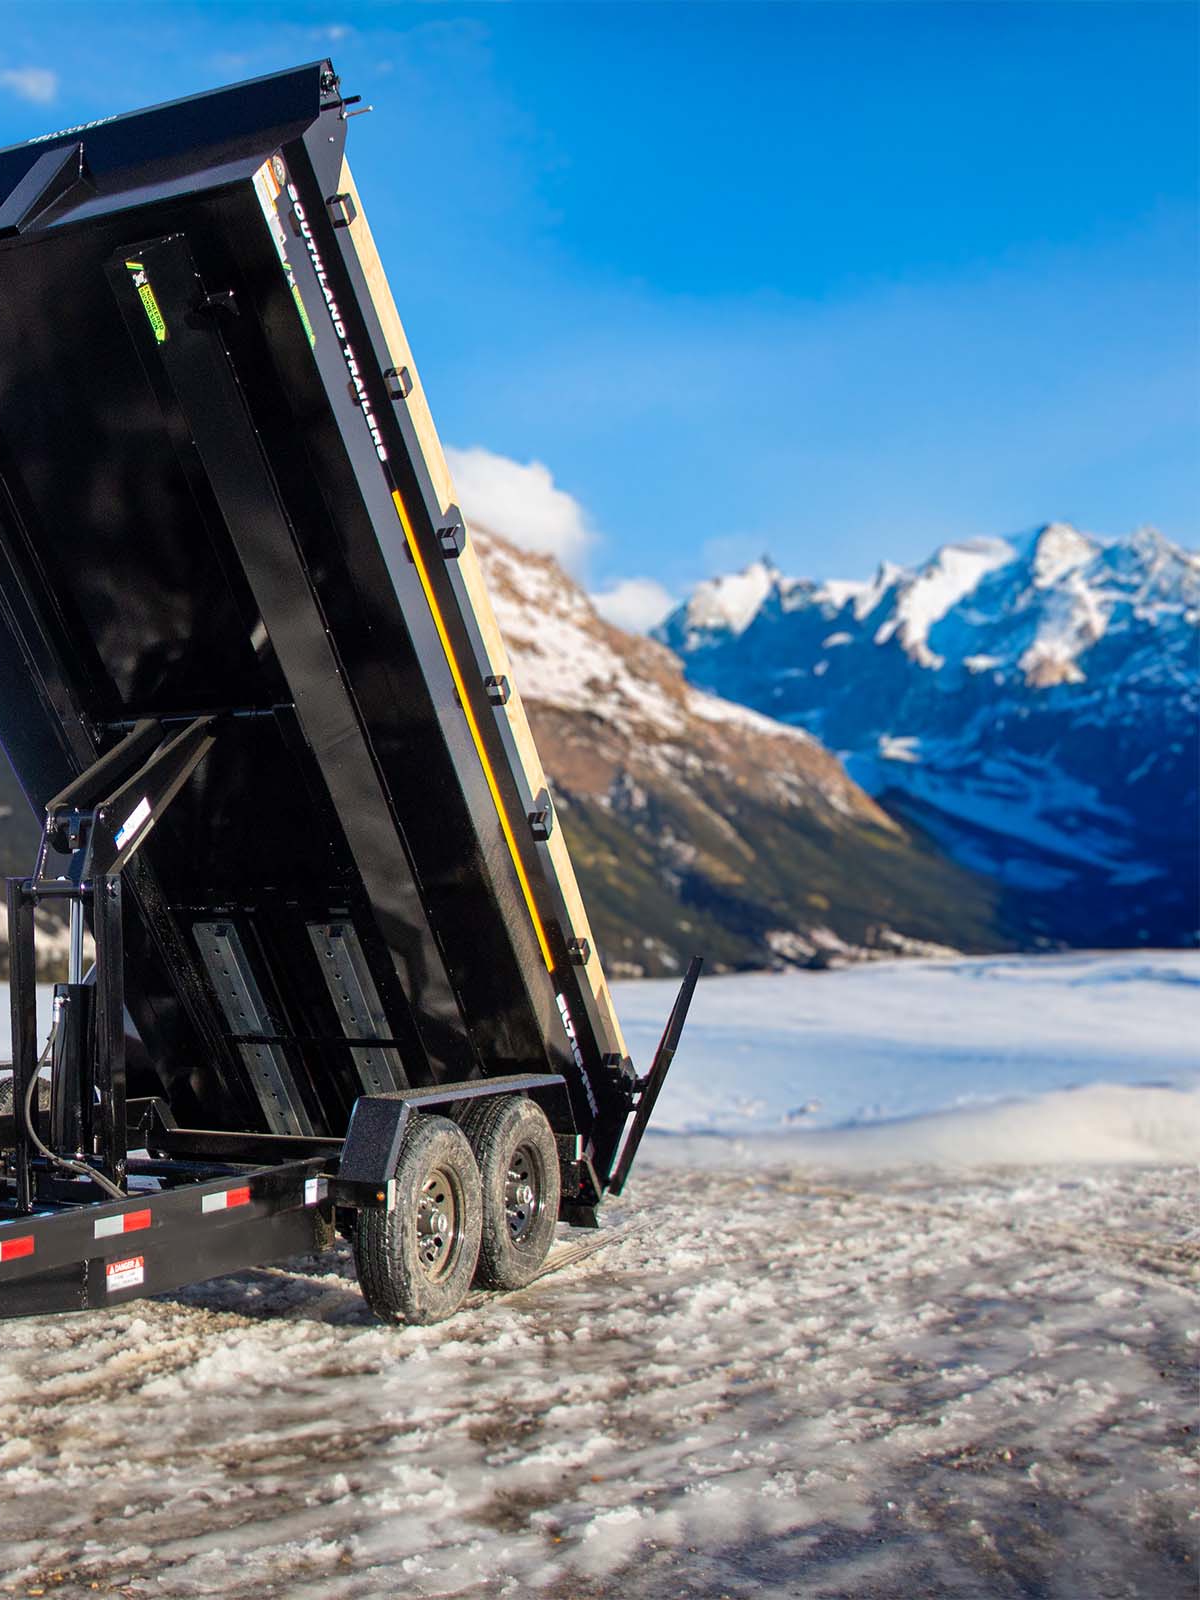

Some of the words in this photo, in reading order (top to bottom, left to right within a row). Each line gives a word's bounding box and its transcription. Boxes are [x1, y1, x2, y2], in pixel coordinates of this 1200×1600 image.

[144, 286, 165, 330] ENGINEERED
[286, 183, 346, 341] SOUTHLAND
[342, 343, 388, 463] TRAILERS
[114, 1260, 135, 1272] DANGER
